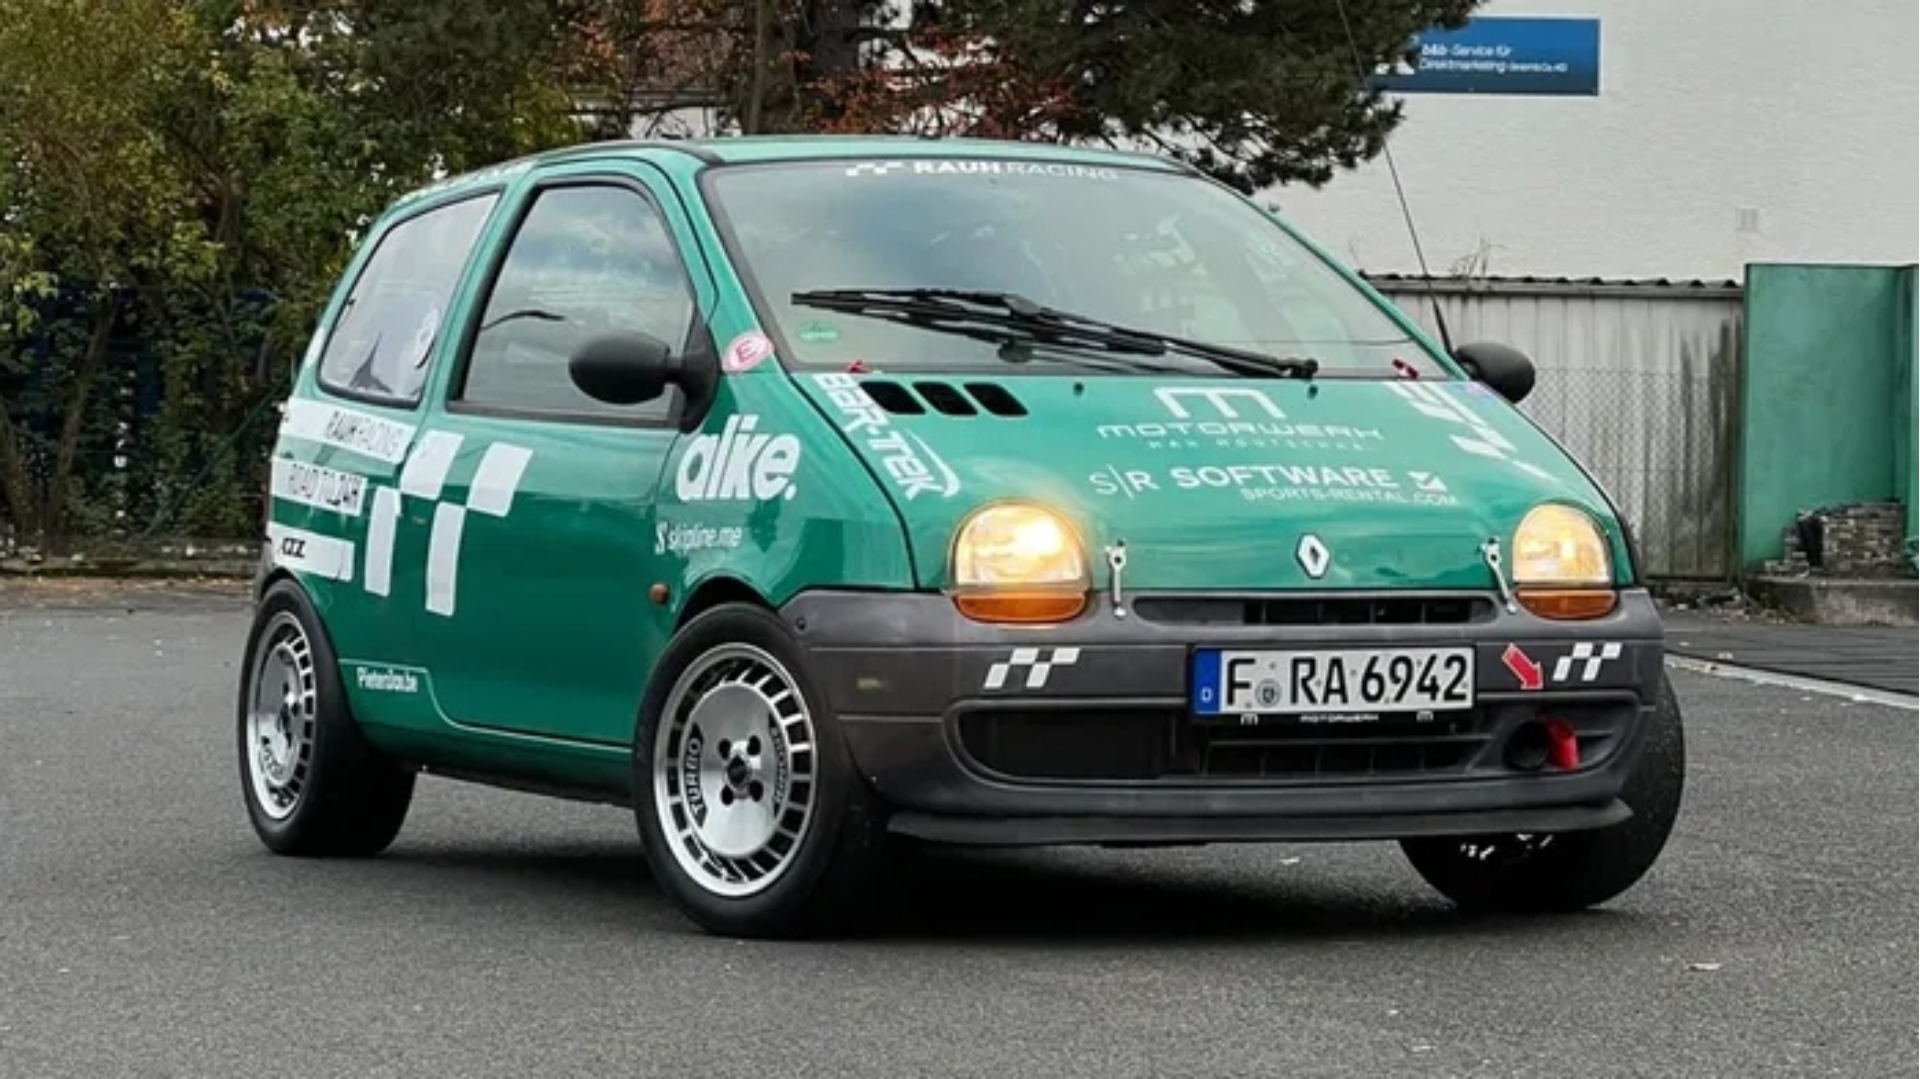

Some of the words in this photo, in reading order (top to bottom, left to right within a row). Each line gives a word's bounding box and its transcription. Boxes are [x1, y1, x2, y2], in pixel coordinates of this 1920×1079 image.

[913, 160, 1001, 175] RAUH
[1003, 162, 1119, 181] RACING
[735, 340, 758, 363] E
[675, 413, 800, 501] alike.
[1170, 465, 1399, 489] SOFTWARE
[1201, 688, 1213, 702] D
[1227, 658, 1256, 706] F
[1290, 656, 1349, 706] RA
[1360, 654, 1468, 703] 6942
[685, 737, 703, 816] TURBO
